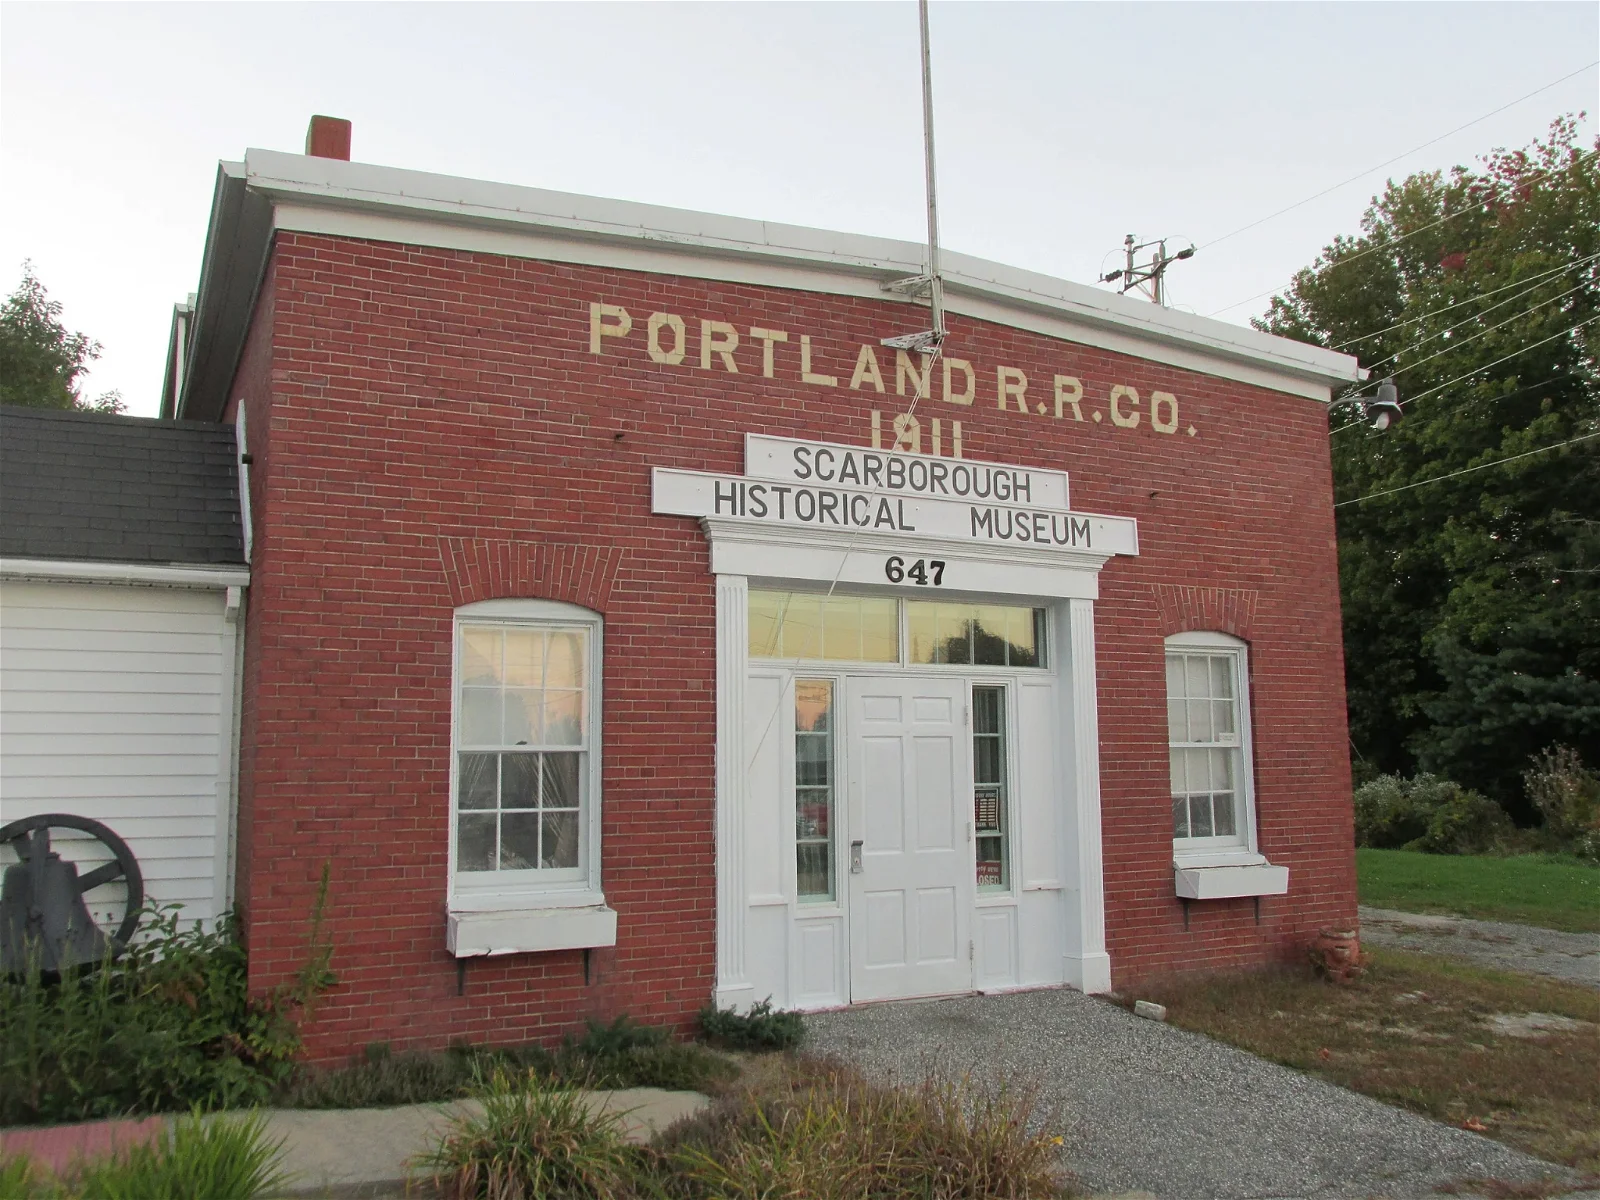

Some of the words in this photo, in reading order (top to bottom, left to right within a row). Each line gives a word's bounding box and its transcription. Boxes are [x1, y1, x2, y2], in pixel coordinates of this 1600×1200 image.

[589, 303, 976, 406] PORTLAND
[871, 409, 962, 458] 1911
[793, 446, 1031, 502] SCARBOROUGH
[714, 480, 916, 531] HISTORICAL
[970, 506, 1091, 548] MUSEUM
[885, 555, 946, 586] 647
